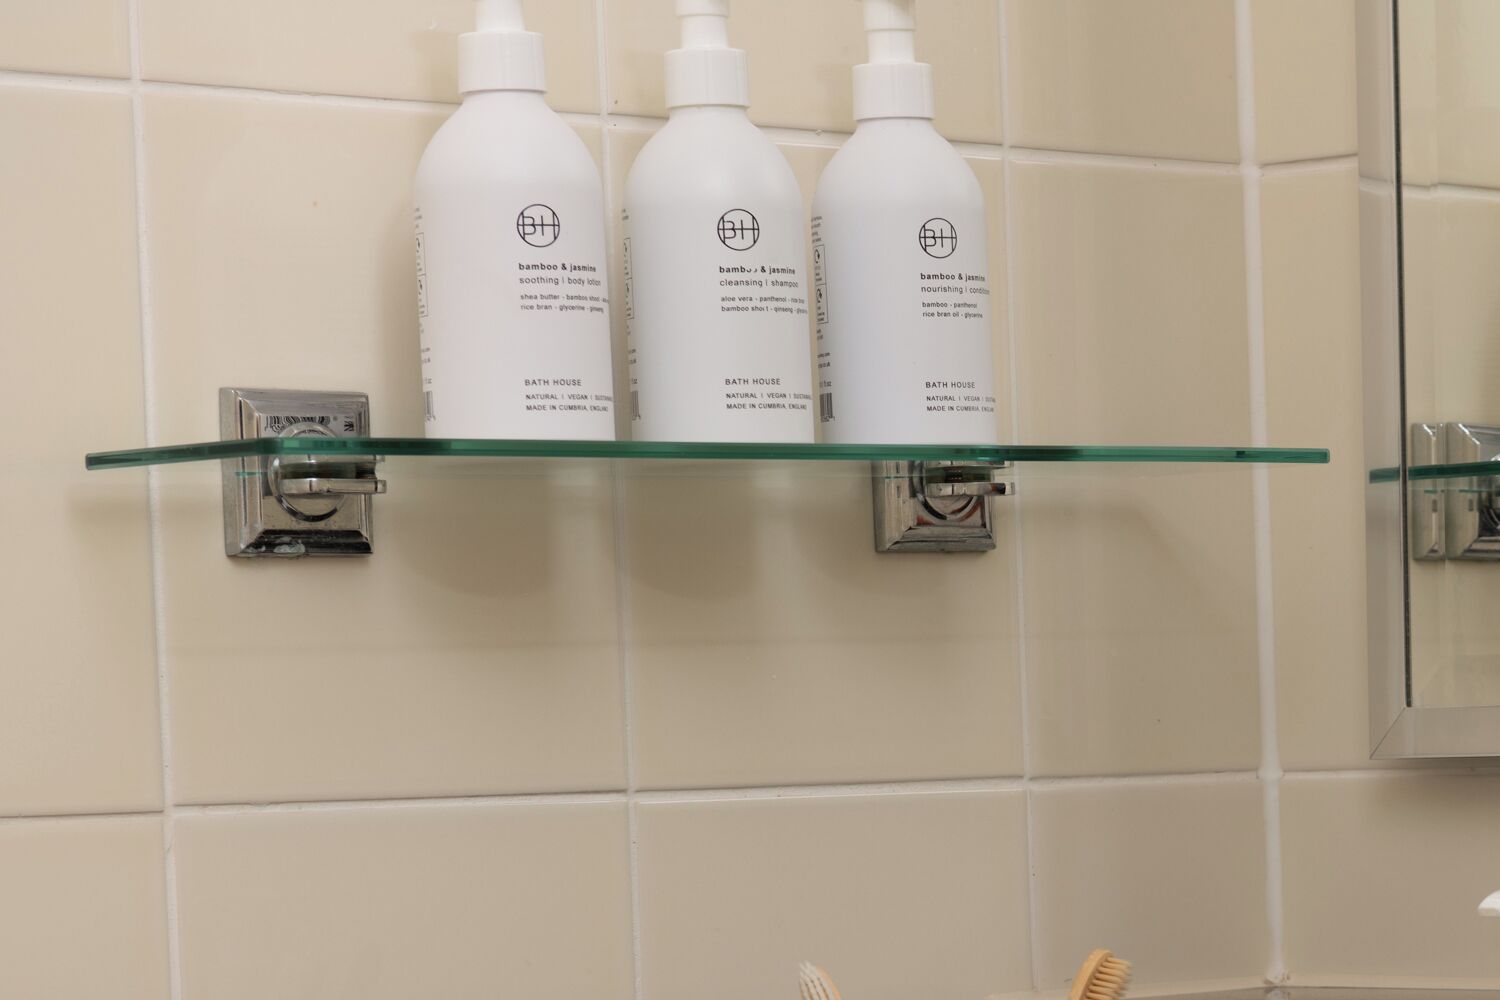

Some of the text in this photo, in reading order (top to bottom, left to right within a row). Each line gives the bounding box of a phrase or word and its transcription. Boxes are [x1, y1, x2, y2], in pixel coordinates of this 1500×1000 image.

[570, 264, 596, 273] jasmine
[769, 266, 795, 275] jasmine
[519, 276, 559, 285] soothing
[568, 277, 585, 286] body
[720, 279, 763, 288] cleansing
[921, 285, 963, 294] nourishing
